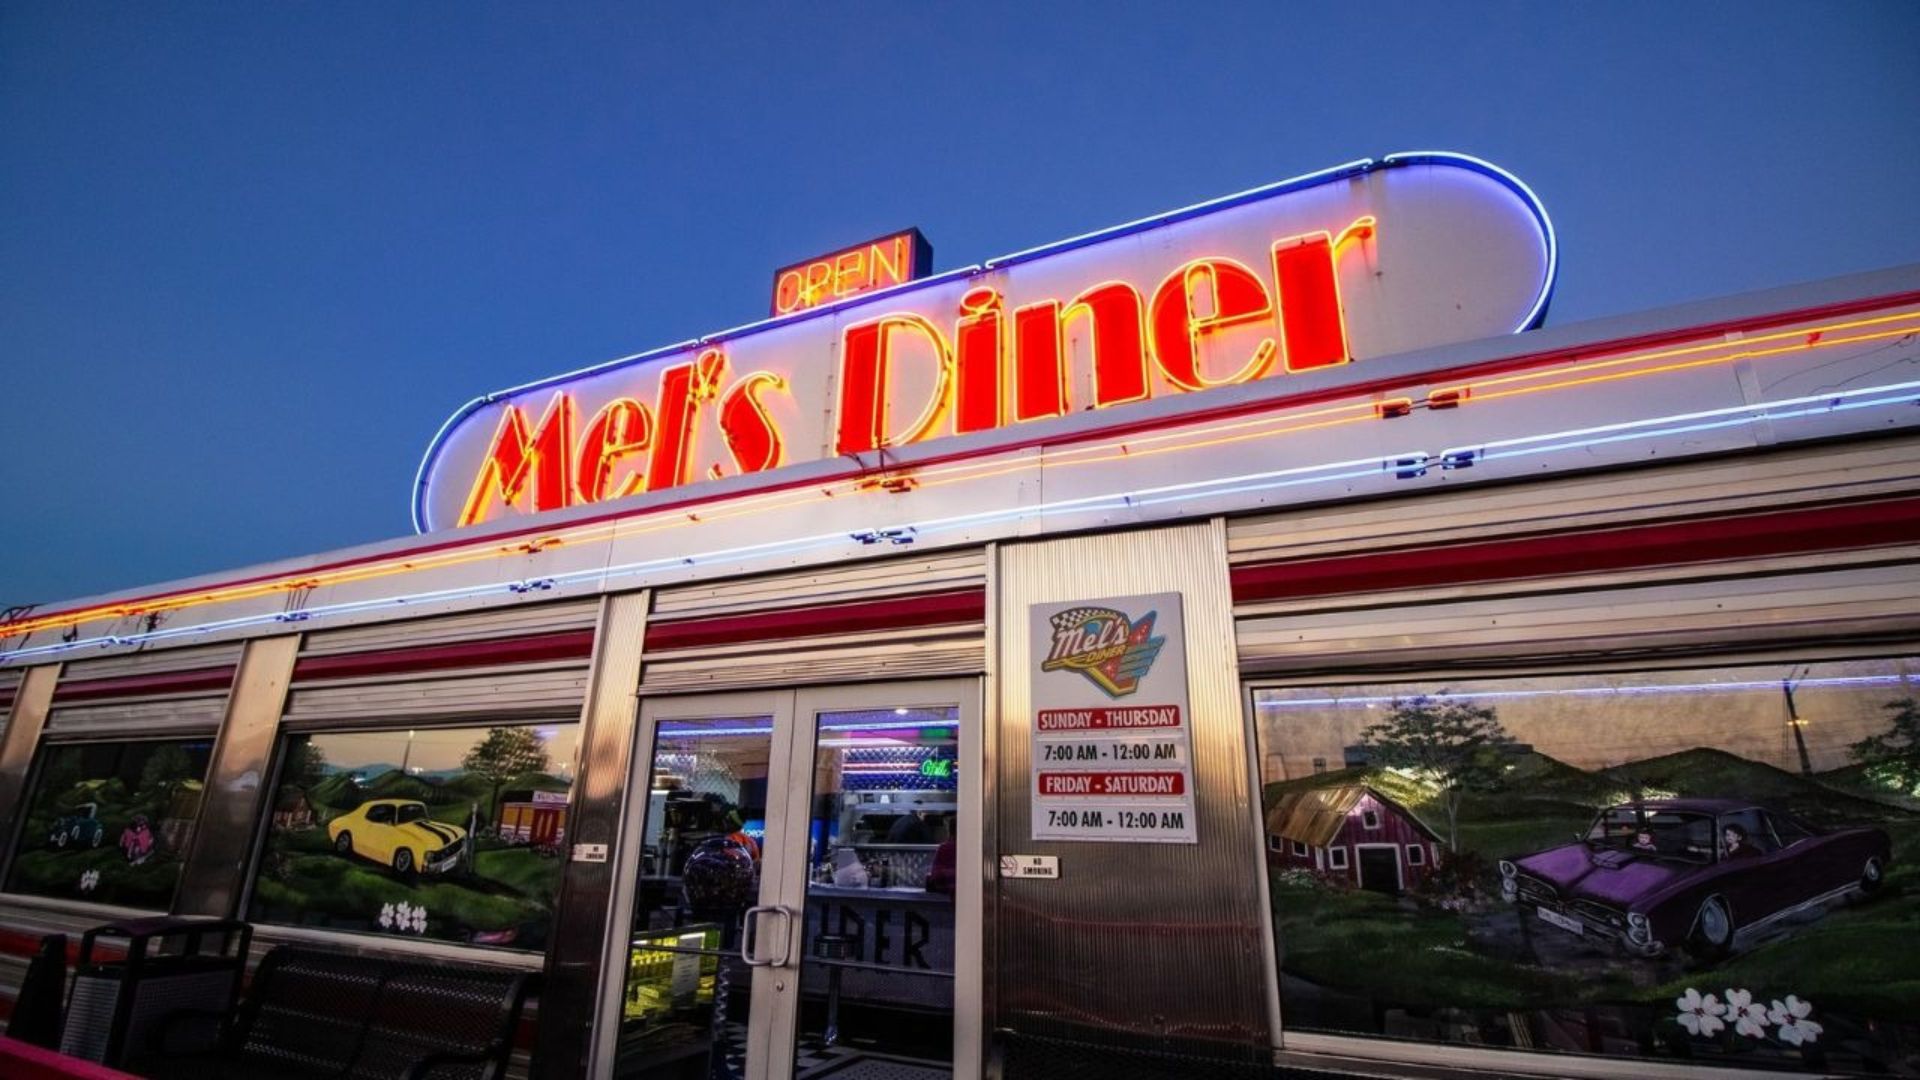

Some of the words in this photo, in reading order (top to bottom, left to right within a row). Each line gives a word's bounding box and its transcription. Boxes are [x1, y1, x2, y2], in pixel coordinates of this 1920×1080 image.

[776, 237, 902, 313] OPEN
[457, 348, 784, 528] Mel's
[835, 215, 1377, 457] Diner
[1052, 617, 1128, 660] Mel's
[1086, 644, 1127, 663] DINER
[1040, 711, 1093, 729] SUNDAY
[1105, 708, 1176, 727] THURSDAY
[1044, 744, 1073, 761] 7:00
[1077, 744, 1097, 760] AM
[1112, 743, 1150, 760] 12:00
[1154, 743, 1177, 760] AM
[1046, 775, 1093, 793] FRIDAY
[1104, 775, 1175, 793] SATURDAY
[1048, 810, 1078, 828] 7:00
[1081, 810, 1103, 828] AM
[1118, 811, 1157, 829] 12:00
[1161, 812, 1185, 829] AM
[1023, 866, 1053, 875] SMOKING
